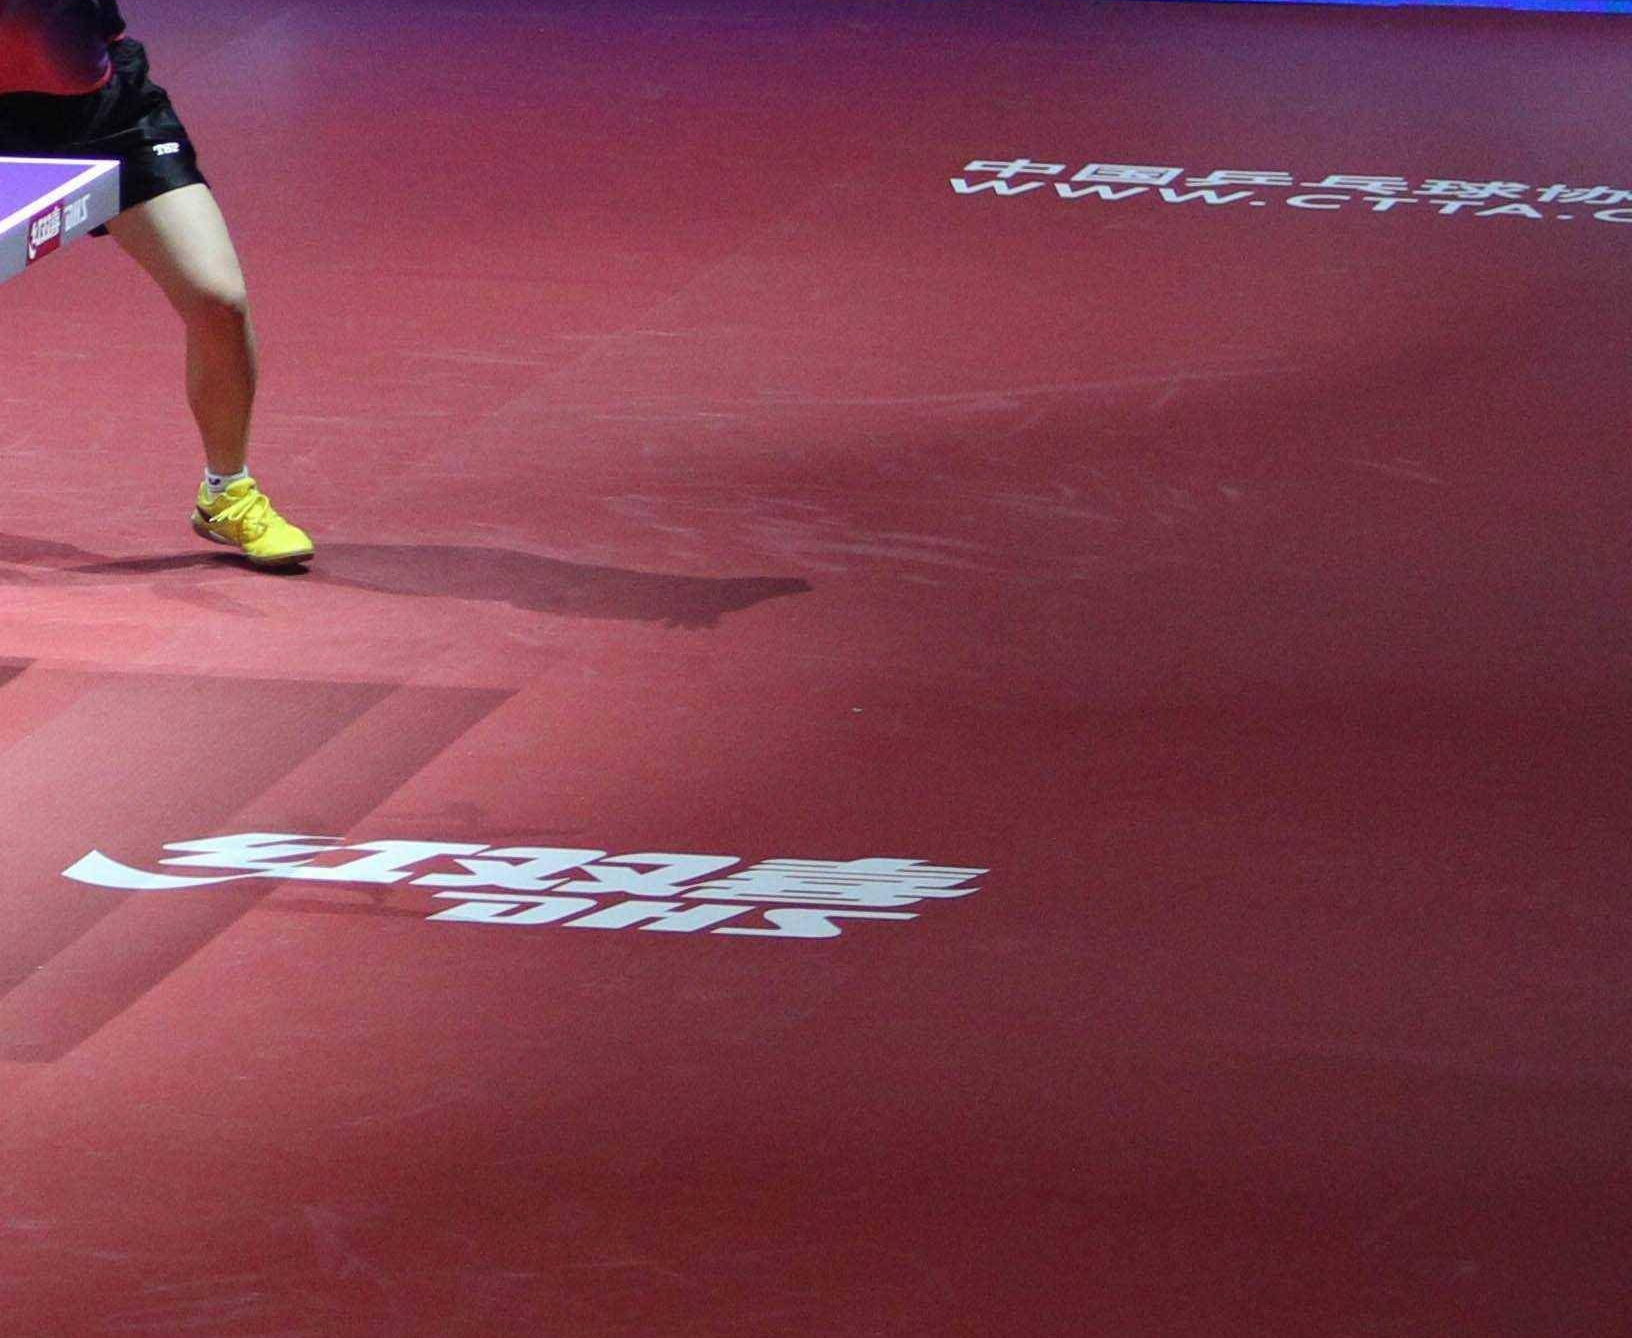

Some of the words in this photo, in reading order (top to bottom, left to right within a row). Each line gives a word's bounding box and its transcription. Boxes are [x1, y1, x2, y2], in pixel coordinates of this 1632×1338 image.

[62, 832, 991, 905] 红双喜
[426, 891, 920, 939] DHS
